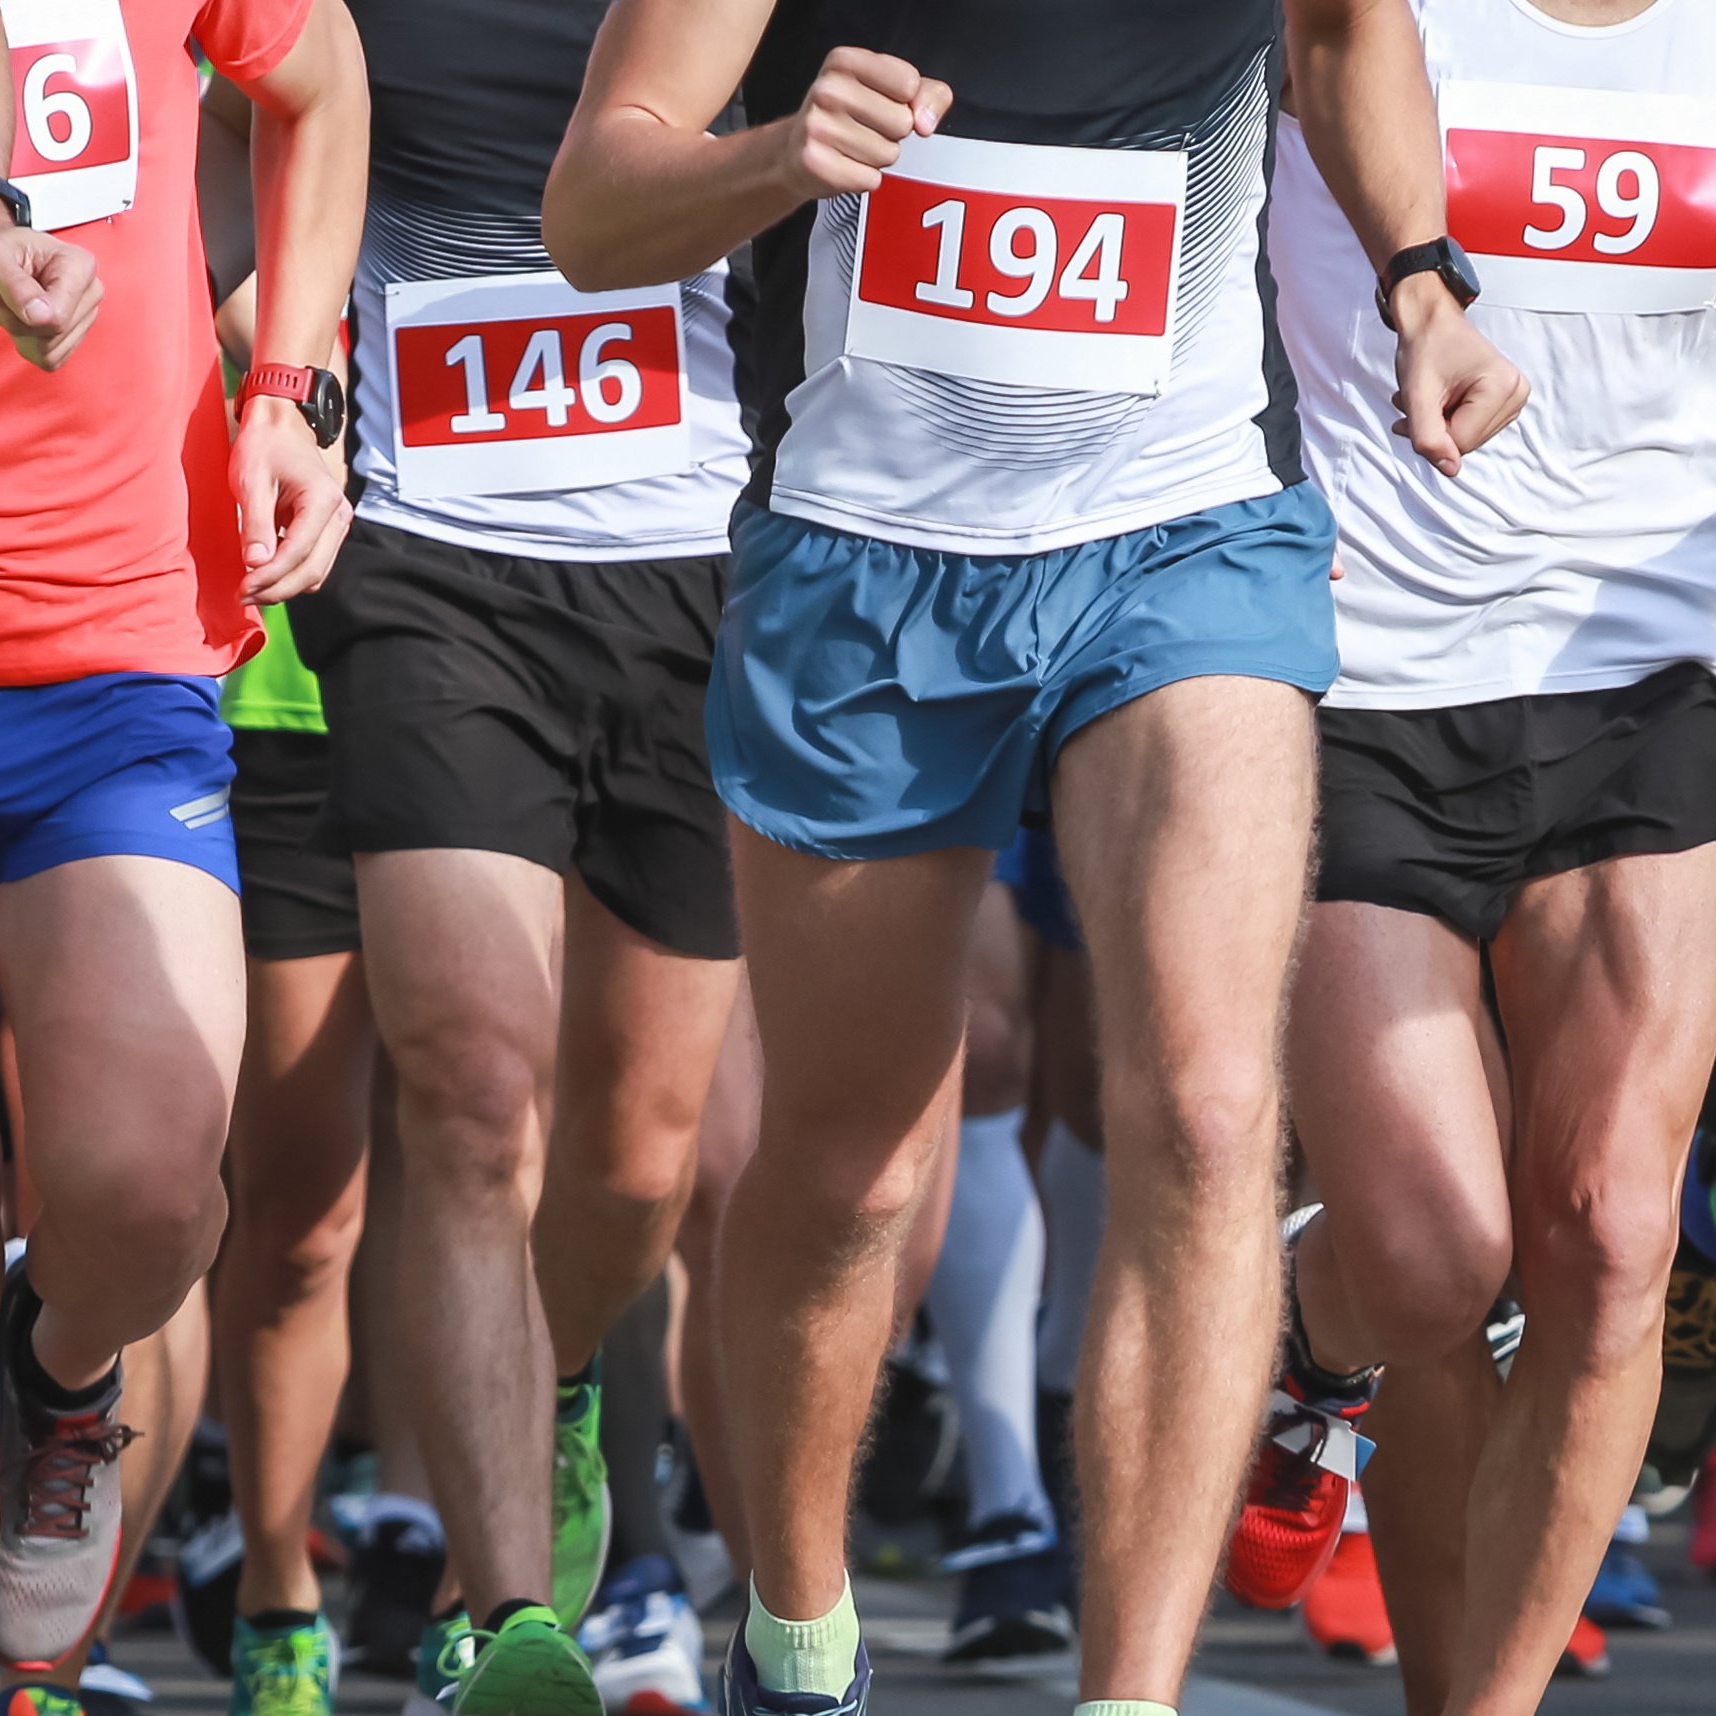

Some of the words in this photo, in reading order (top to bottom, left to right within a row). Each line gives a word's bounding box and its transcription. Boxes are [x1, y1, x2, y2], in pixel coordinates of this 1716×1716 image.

[1522, 145, 1660, 256] 59
[915, 199, 1129, 323] 194
[445, 322, 643, 433] 146
